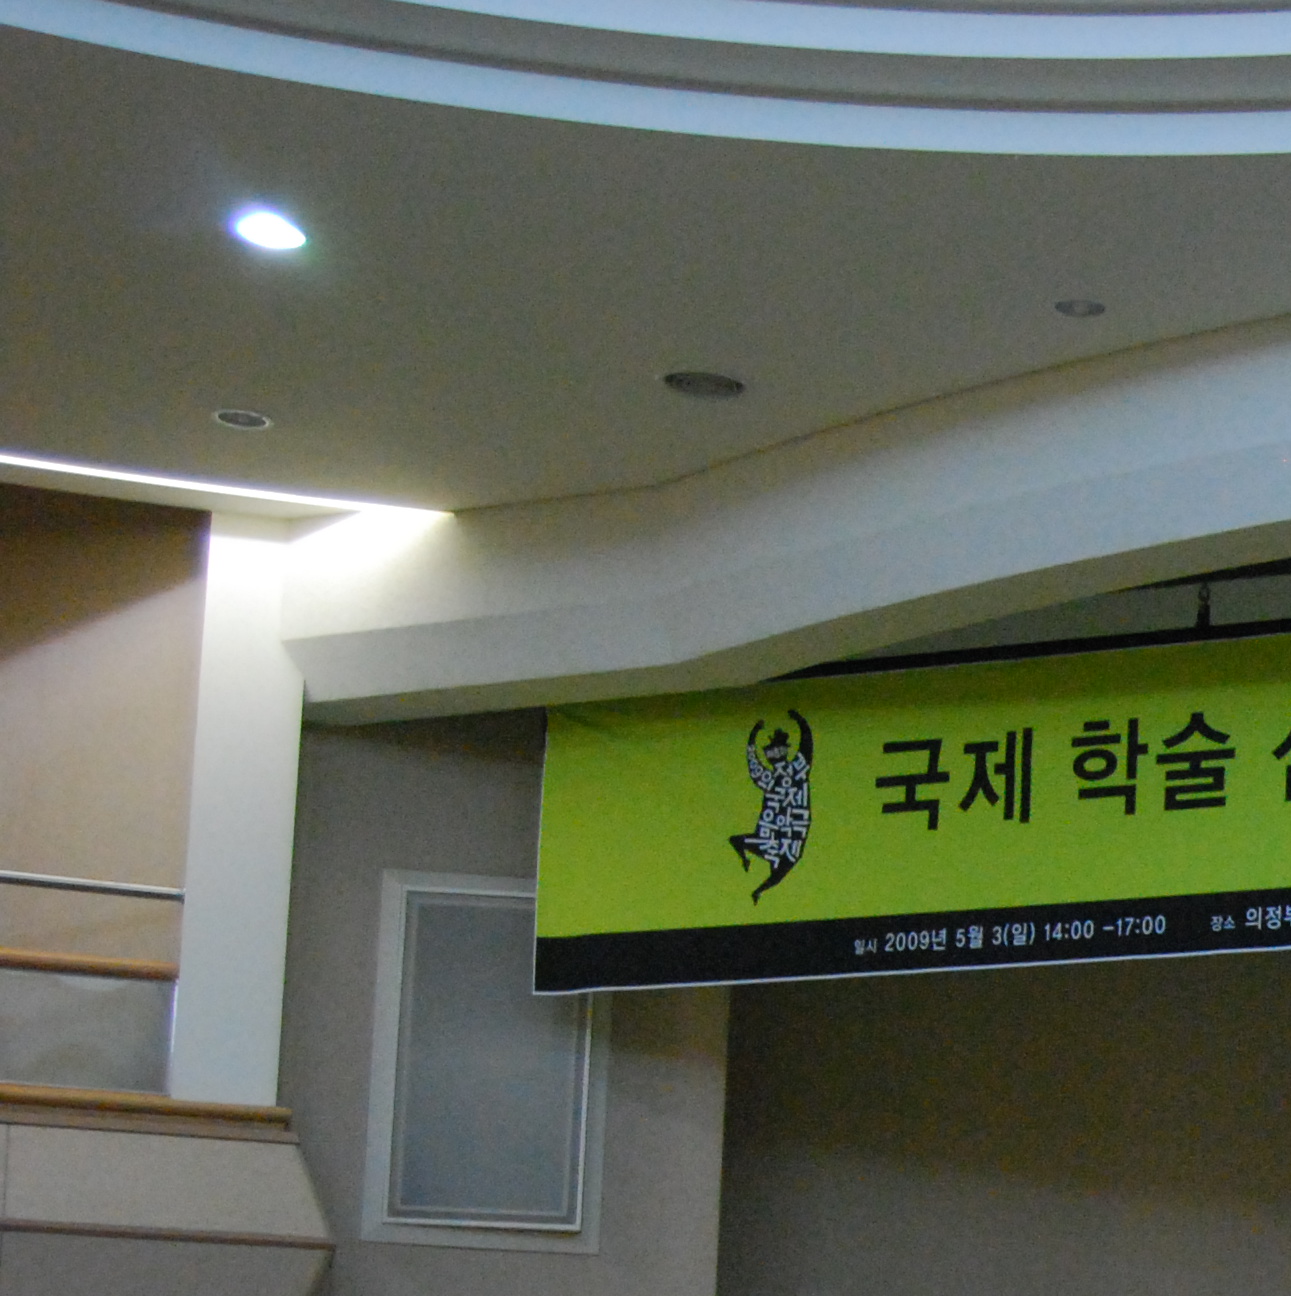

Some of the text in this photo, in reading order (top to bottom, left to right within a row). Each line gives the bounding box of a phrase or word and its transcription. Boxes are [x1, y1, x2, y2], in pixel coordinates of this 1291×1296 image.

[875, 727, 1033, 831] 국제
[1071, 712, 1236, 816] 학술
[854, 938, 877, 955] 일시
[884, 928, 946, 952] 2009년
[956, 926, 984, 949] 5월
[992, 923, 1035, 946] 3(일)
[1045, 920, 1094, 941] 14:00
[1211, 913, 1236, 932] 장소
